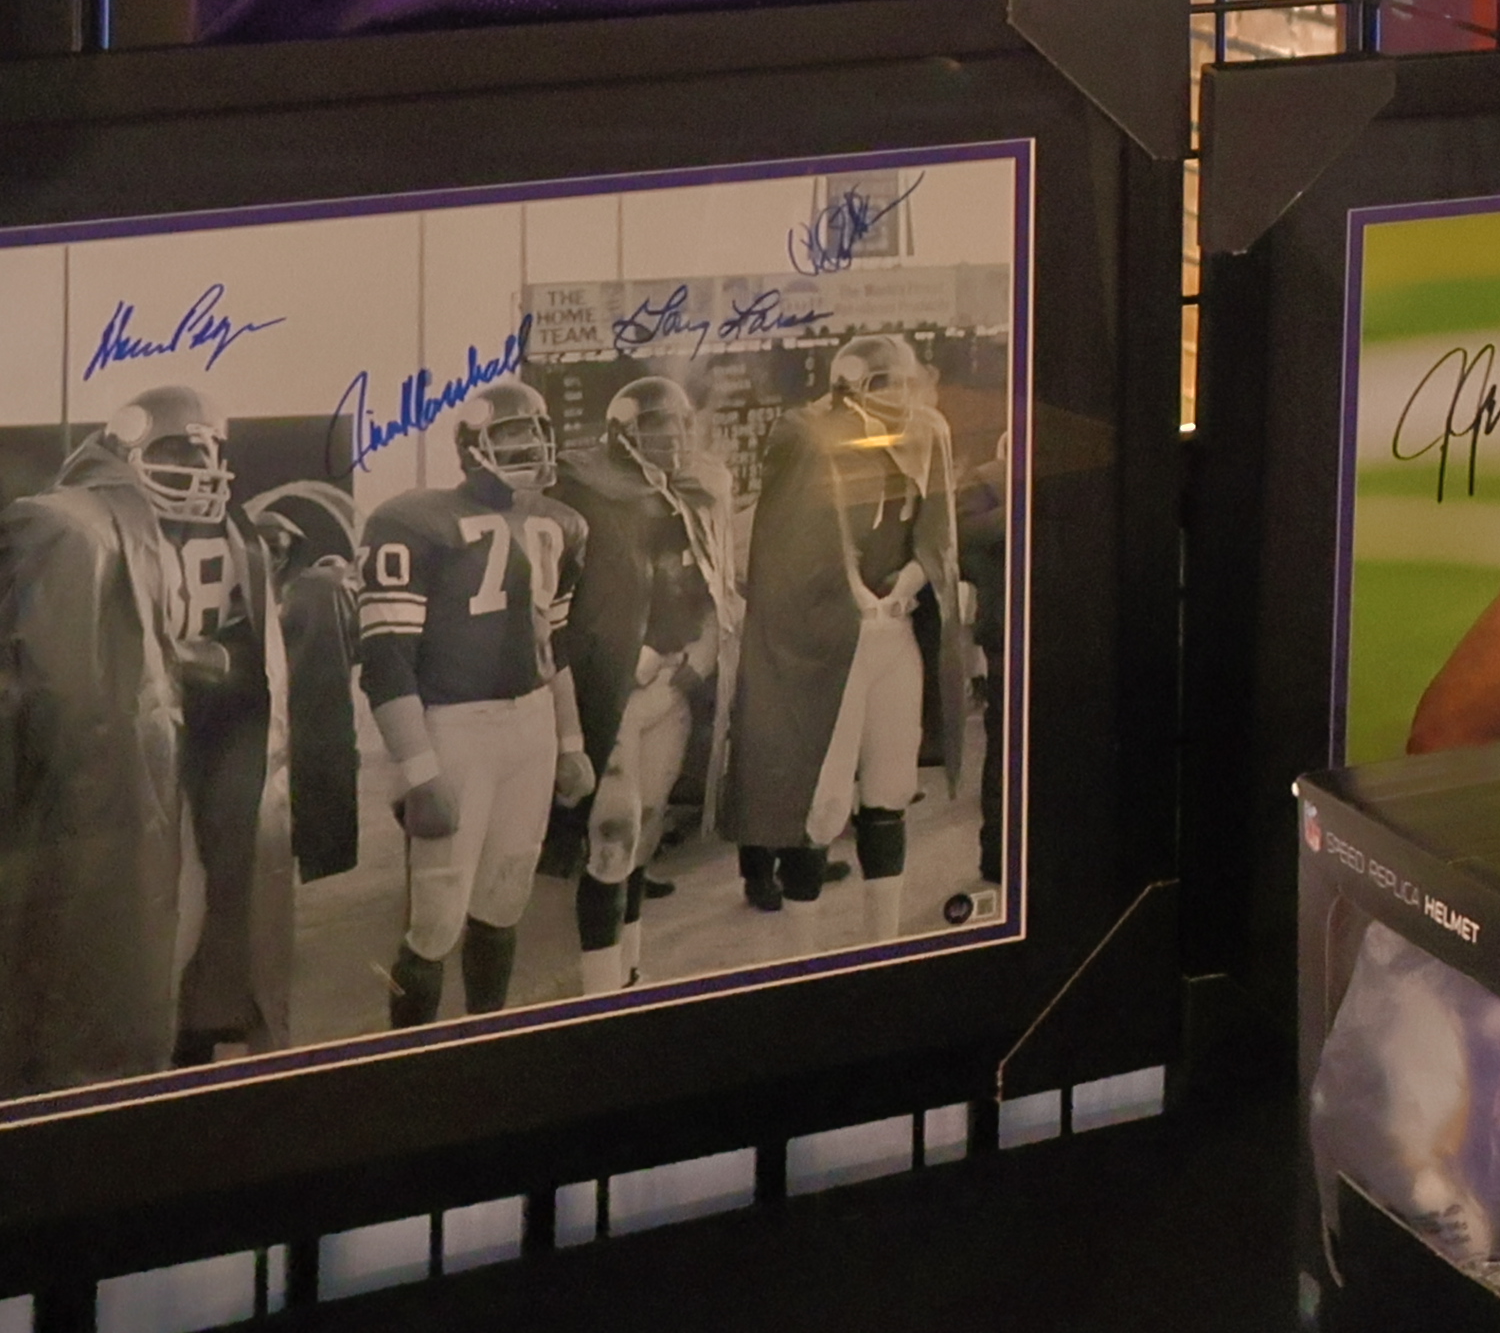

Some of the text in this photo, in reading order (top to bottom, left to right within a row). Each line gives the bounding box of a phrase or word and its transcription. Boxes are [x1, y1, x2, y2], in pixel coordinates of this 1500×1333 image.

[546, 289, 586, 307] THE
[536, 308, 597, 327] HOME
[538, 326, 600, 346] TEAM
[1325, 831, 1366, 875] SPEED
[1423, 893, 1481, 945] HELMET
